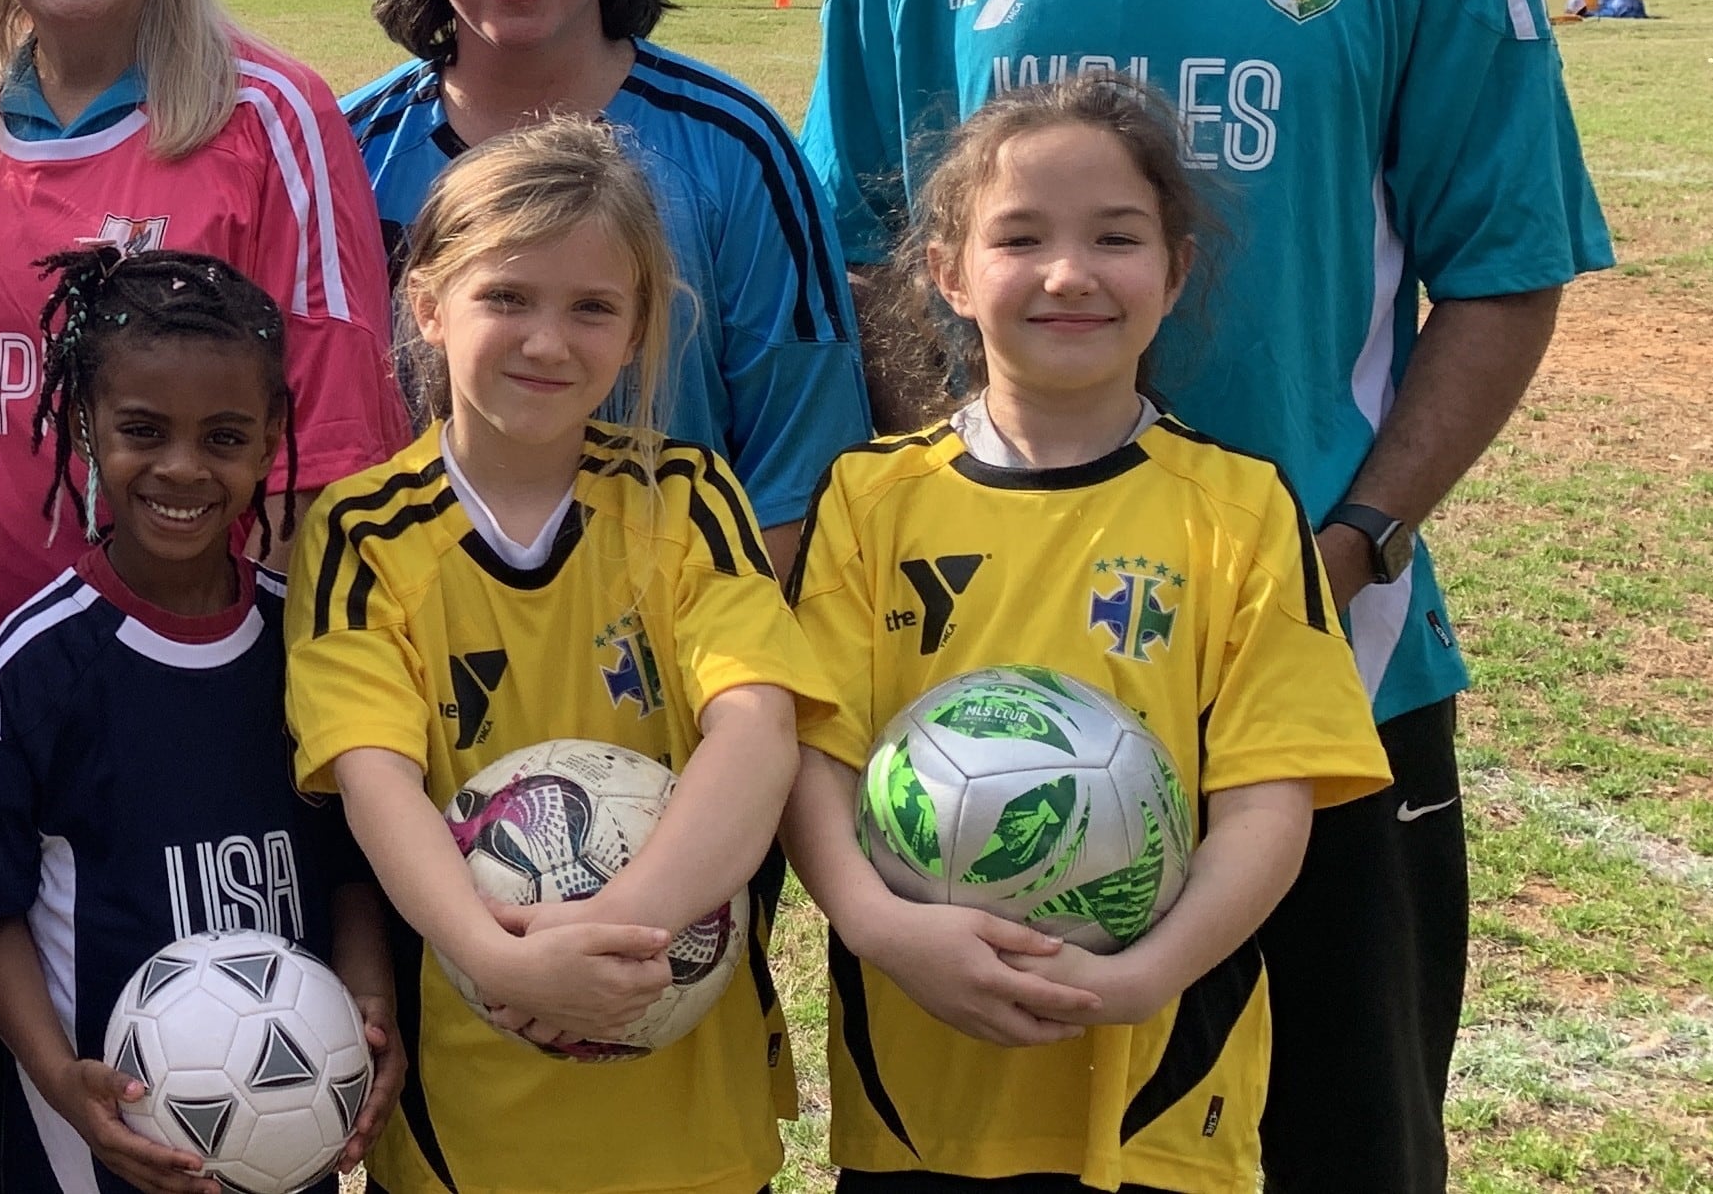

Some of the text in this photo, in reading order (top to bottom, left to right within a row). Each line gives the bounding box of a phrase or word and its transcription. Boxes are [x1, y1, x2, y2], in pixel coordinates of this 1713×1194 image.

[1003, 2, 1024, 24] YMCA
[885, 609, 916, 632] the
[940, 623, 958, 648] YMCA
[965, 705, 992, 718] MLS
[994, 707, 1030, 723] CLUB
[476, 720, 494, 744] YMCA
[164, 829, 305, 942] USA
